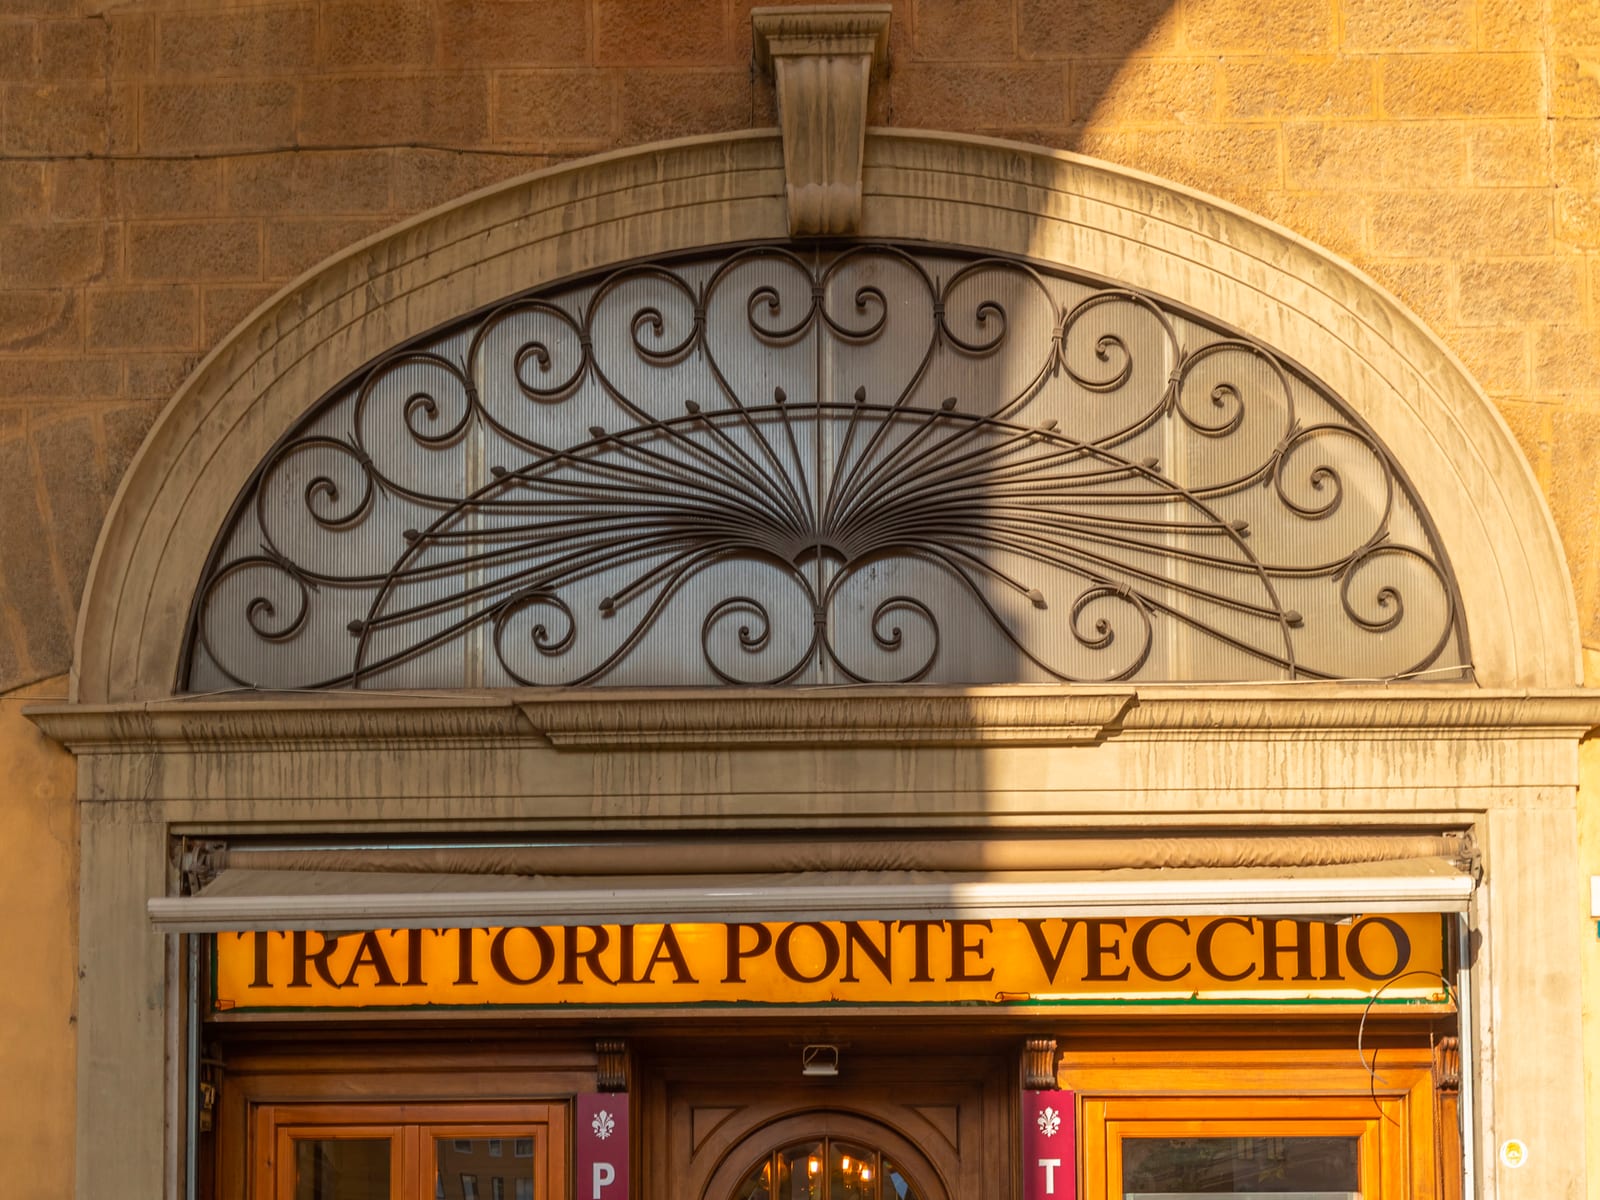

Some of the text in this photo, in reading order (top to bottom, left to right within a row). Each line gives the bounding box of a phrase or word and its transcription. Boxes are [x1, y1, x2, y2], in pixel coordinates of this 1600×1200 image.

[236, 916, 1412, 989] TRATTORIA PONTE VECCHIO
